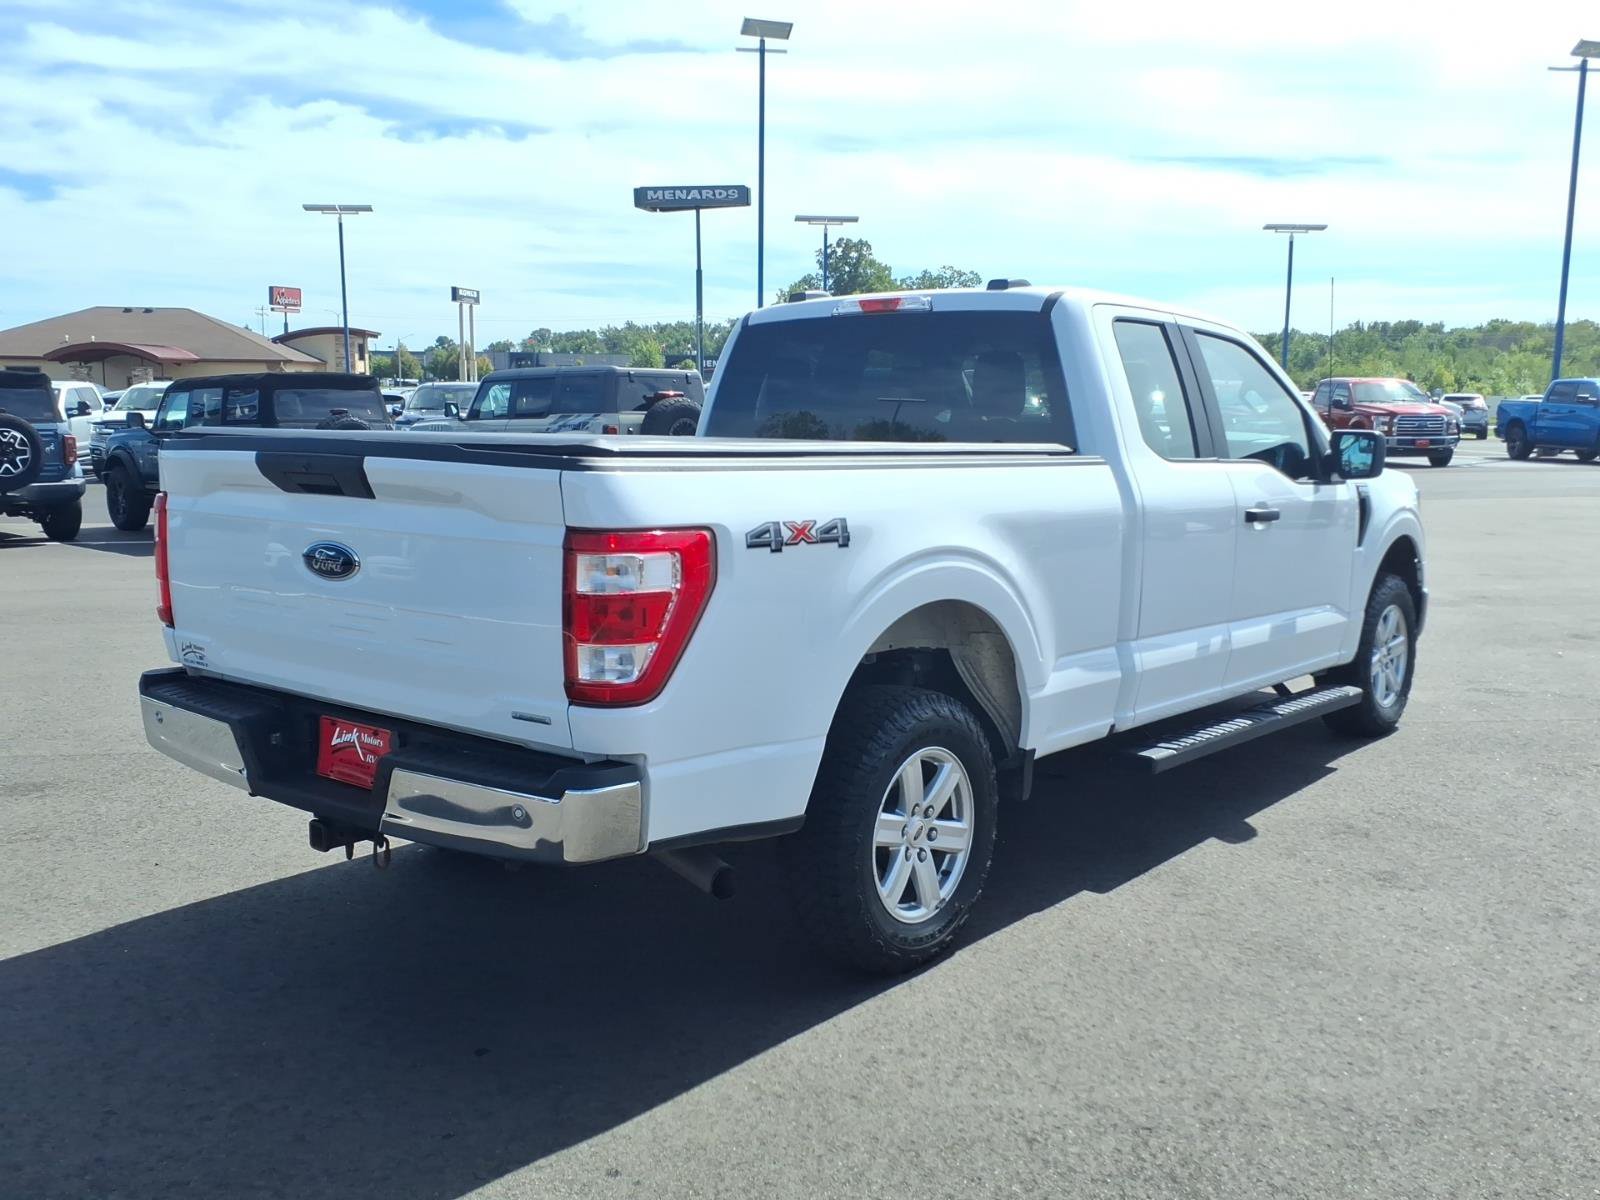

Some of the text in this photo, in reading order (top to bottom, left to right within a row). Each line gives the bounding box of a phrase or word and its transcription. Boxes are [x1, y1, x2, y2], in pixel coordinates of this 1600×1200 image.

[647, 188, 738, 200] MENARDS
[312, 548, 343, 571] Ford
[331, 727, 383, 761] Link Motors
